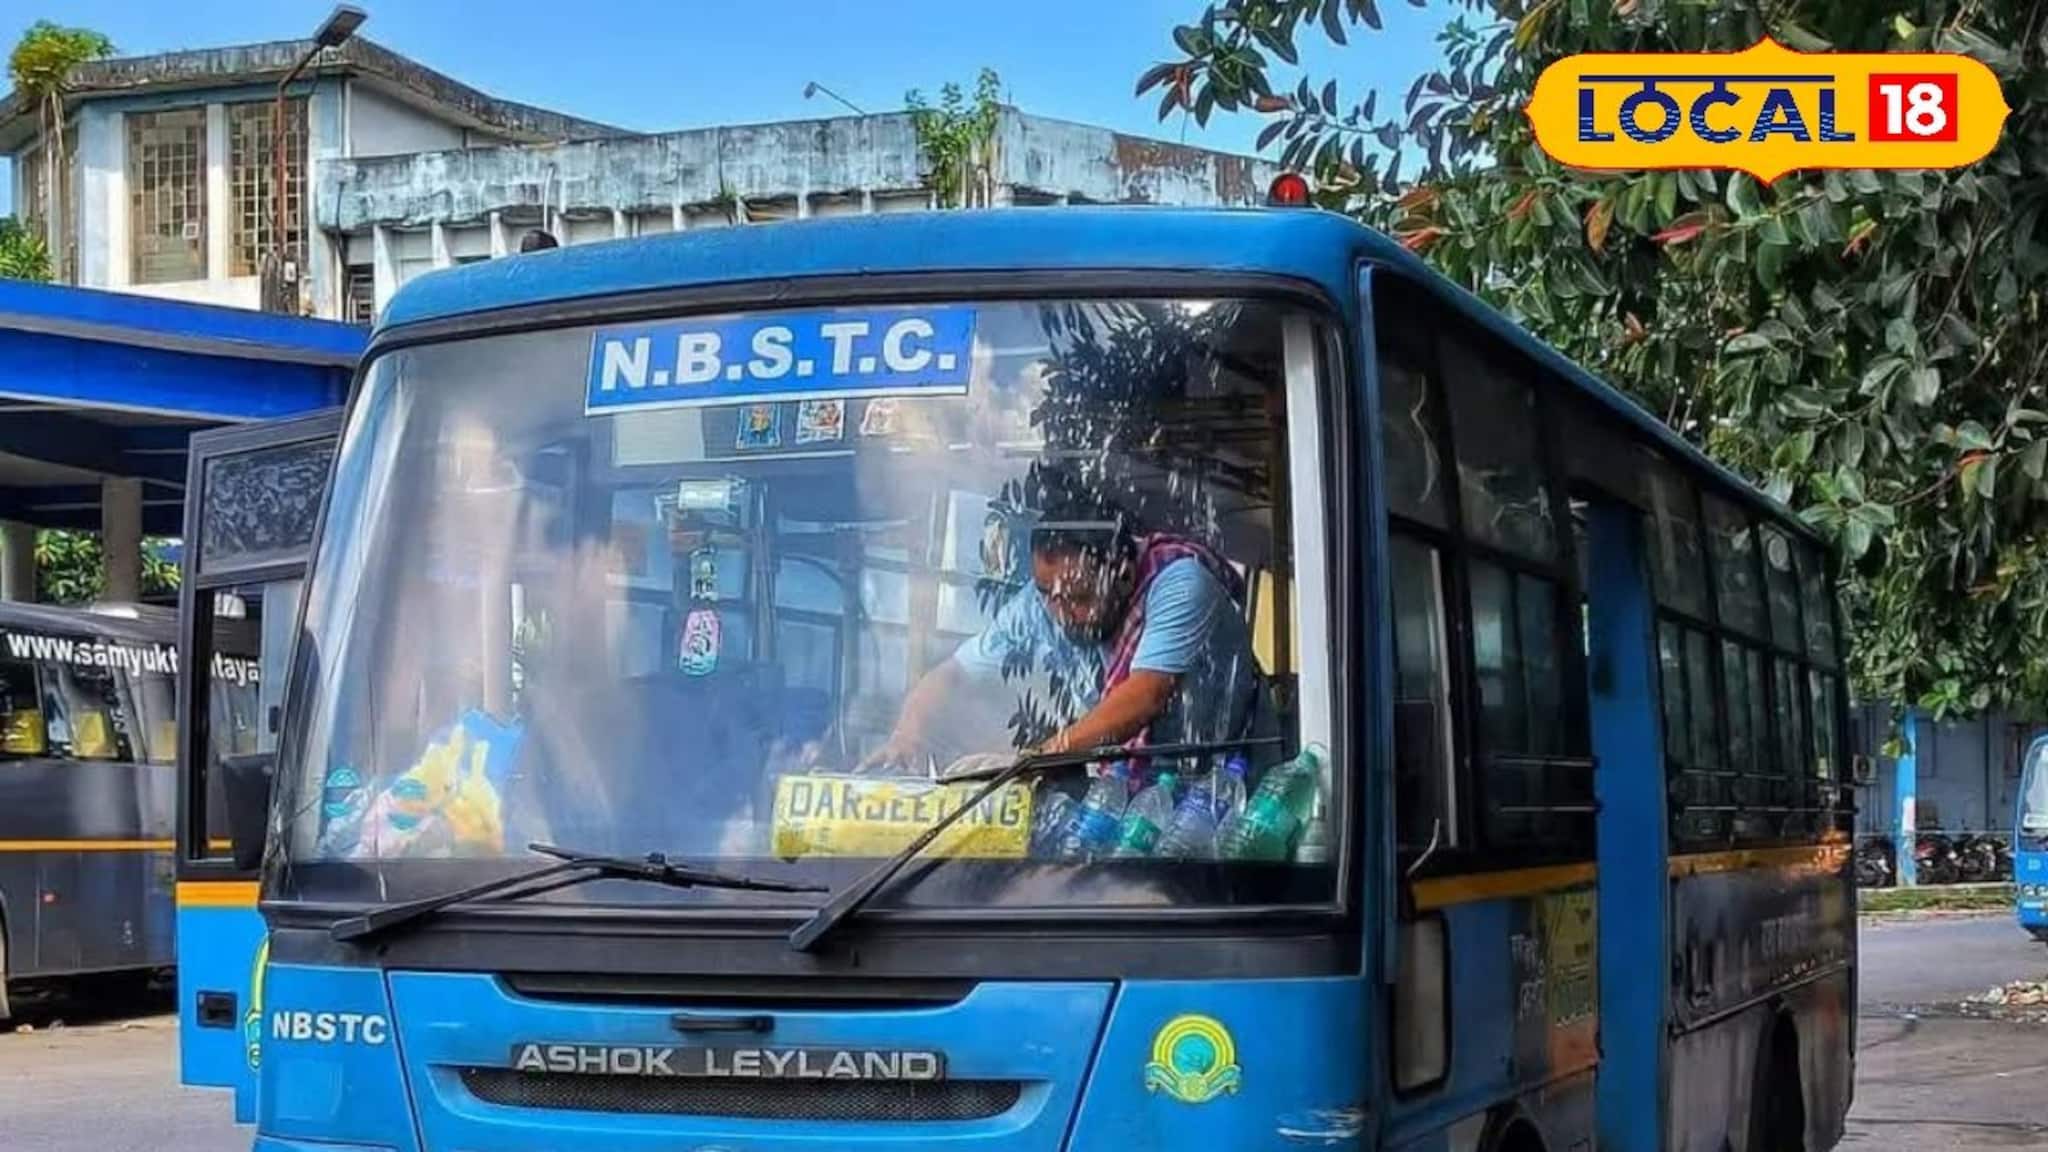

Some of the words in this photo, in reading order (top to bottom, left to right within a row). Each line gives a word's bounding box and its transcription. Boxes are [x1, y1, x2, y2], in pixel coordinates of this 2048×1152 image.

[600, 317, 957, 392] N.B.S.T.C.
[272, 1010, 387, 1045] NBSTC
[514, 1043, 676, 1076] ASHOK
[704, 1048, 938, 1081] LEYLAND
